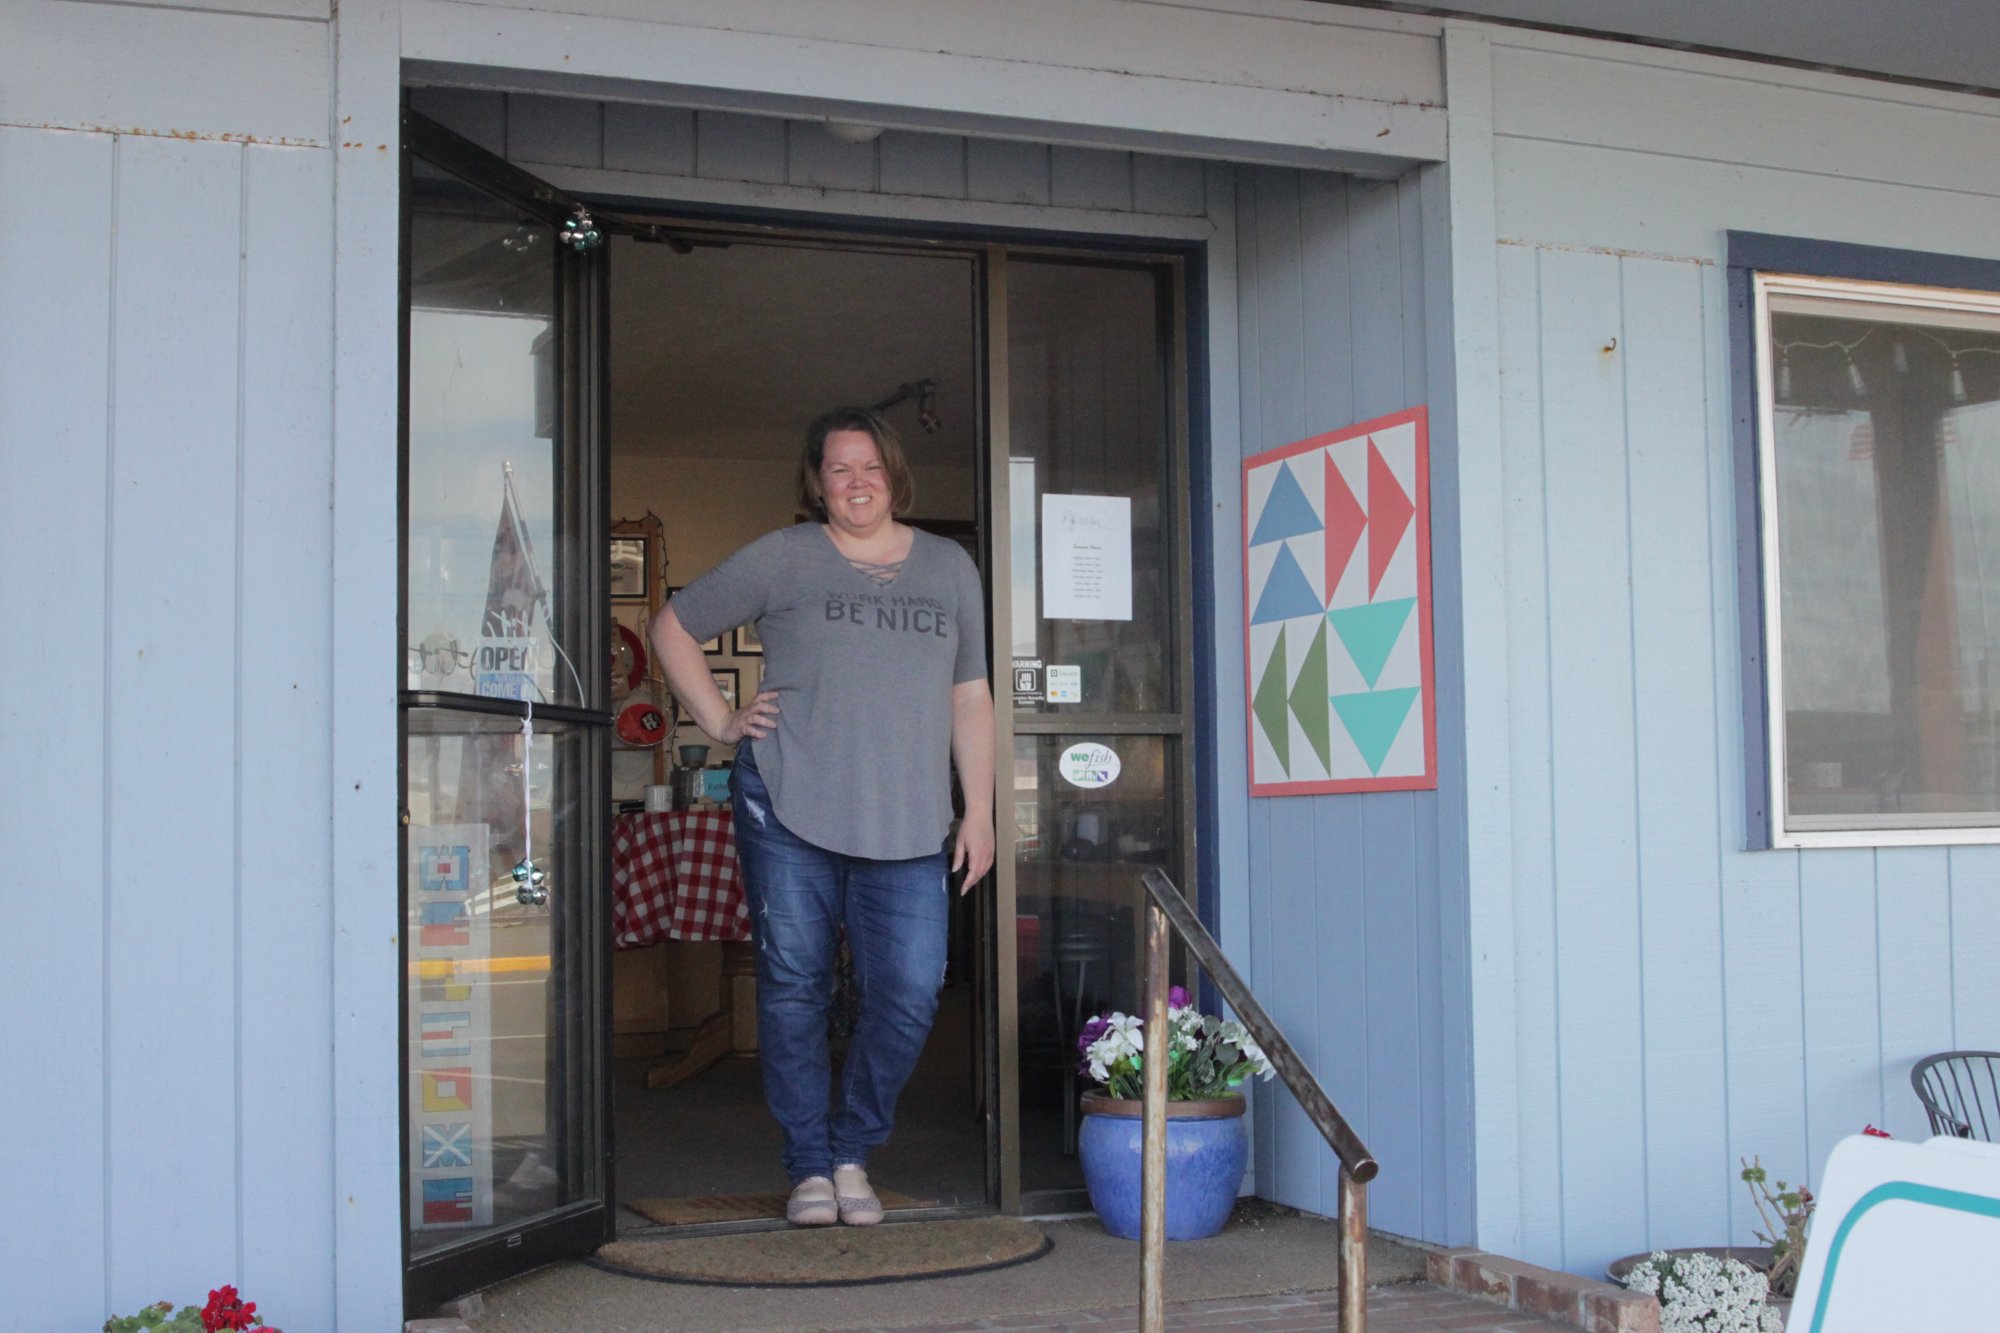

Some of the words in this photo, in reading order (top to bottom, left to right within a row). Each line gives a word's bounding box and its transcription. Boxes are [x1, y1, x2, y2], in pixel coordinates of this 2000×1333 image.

[827, 591, 886, 606] WORK
[891, 595, 944, 610] HARD
[825, 600, 865, 625] BE
[876, 607, 948, 638] NICE
[481, 682, 517, 698] COME
